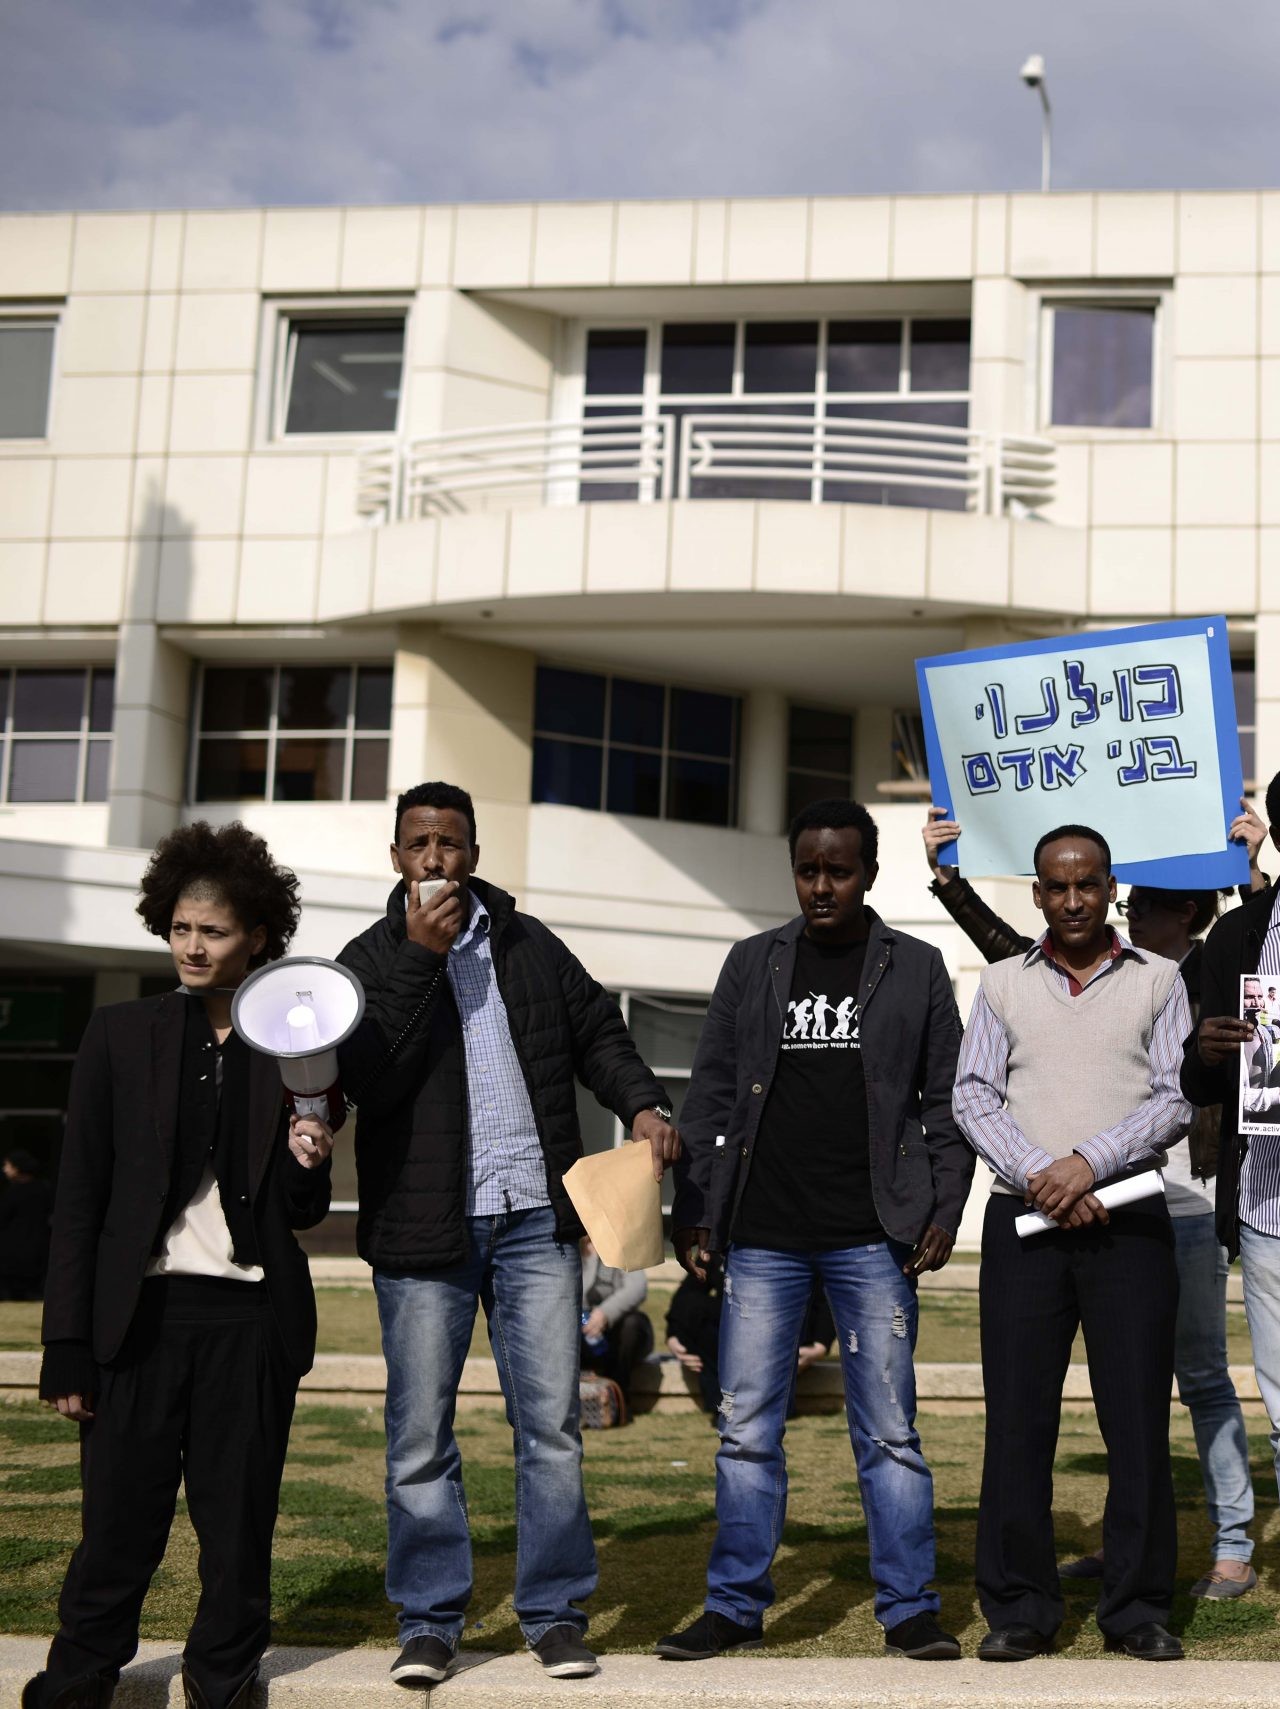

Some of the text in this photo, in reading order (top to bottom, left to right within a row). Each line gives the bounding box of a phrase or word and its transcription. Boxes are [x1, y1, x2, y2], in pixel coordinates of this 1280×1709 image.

[962, 735, 1197, 796] בני אדם
[791, 1041, 829, 1050] somewhere
[830, 1041, 848, 1049] went
